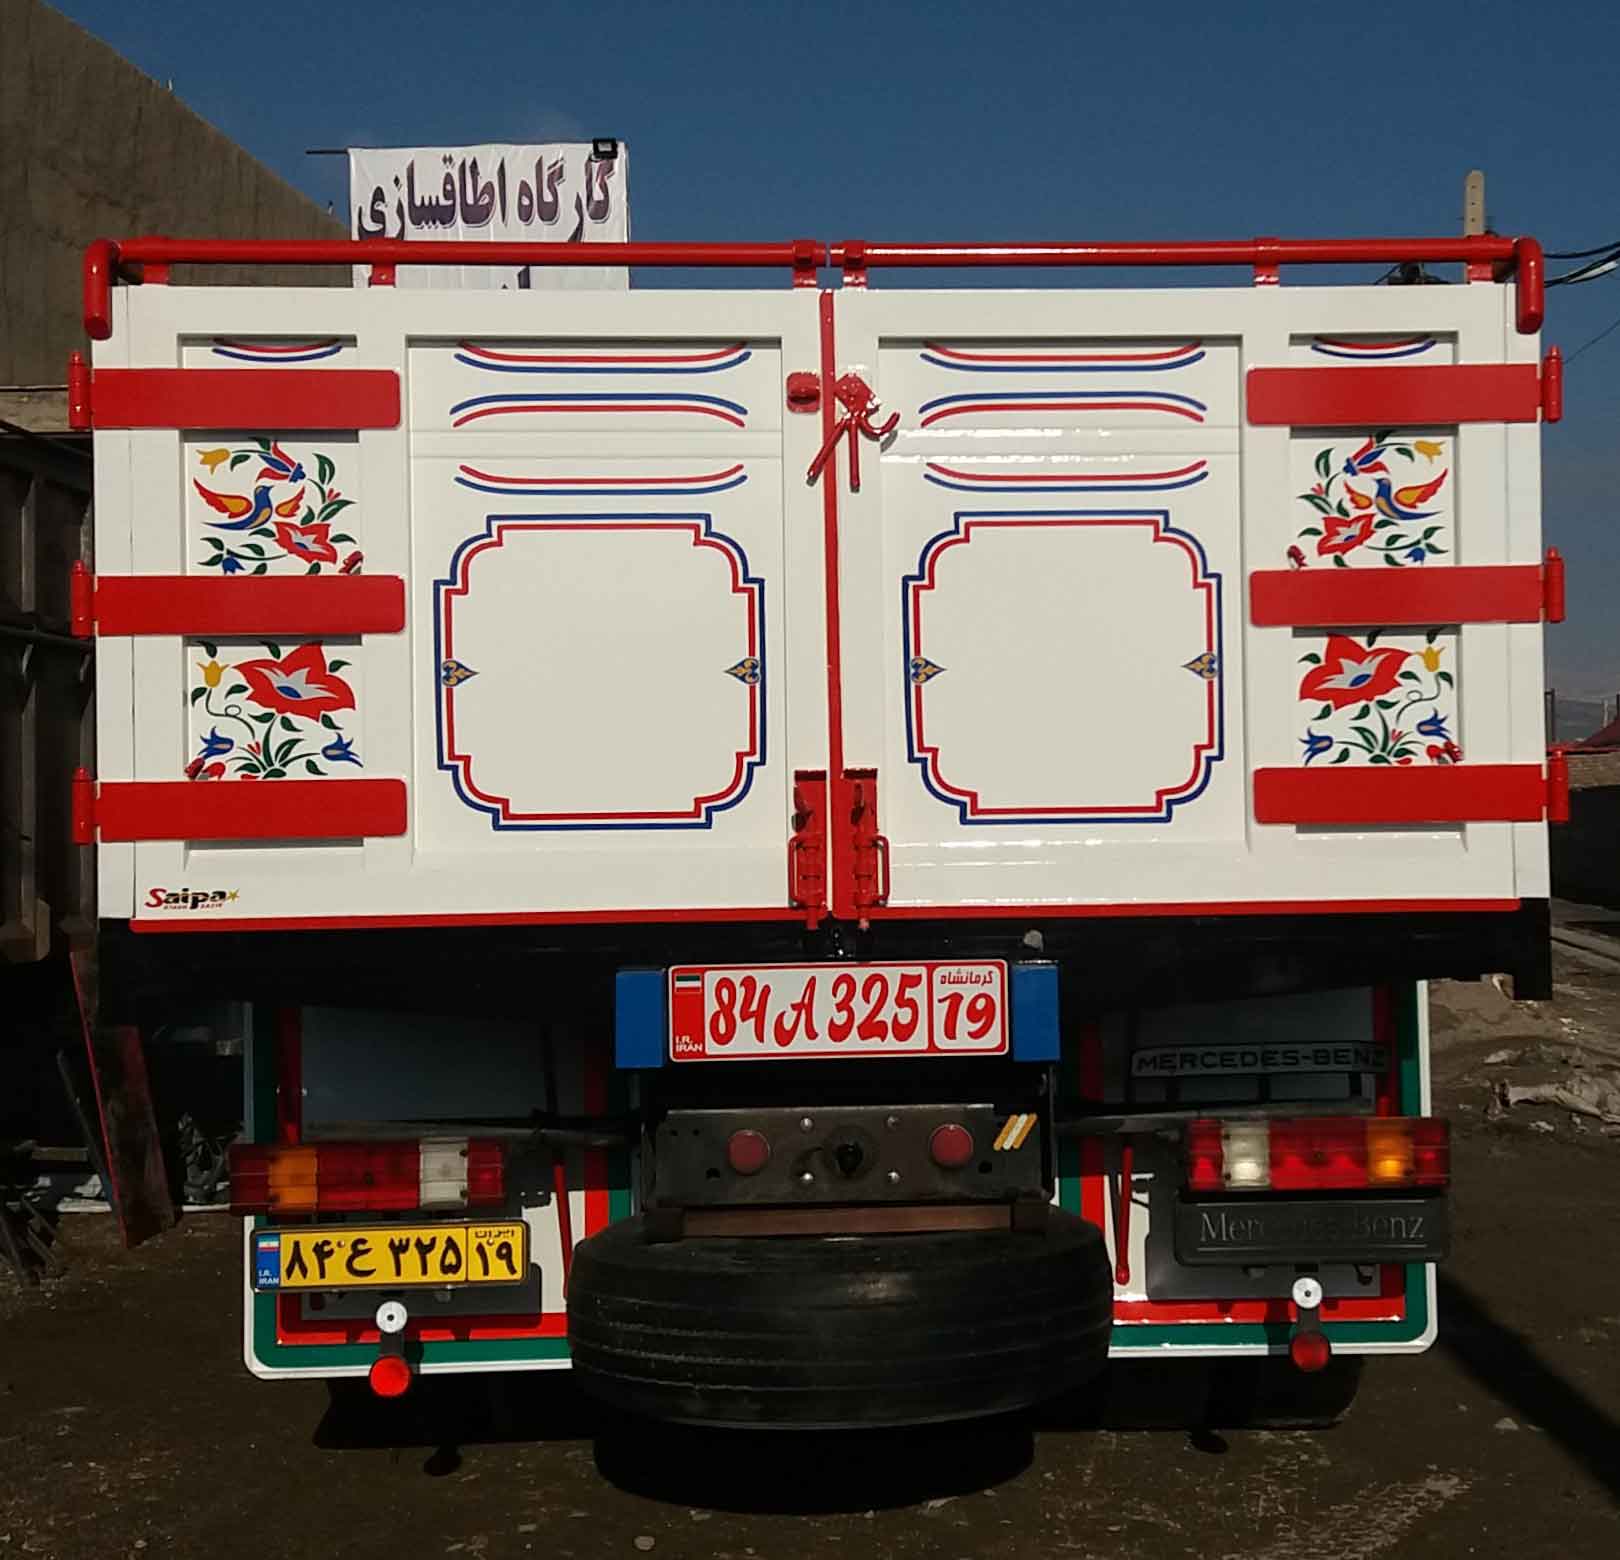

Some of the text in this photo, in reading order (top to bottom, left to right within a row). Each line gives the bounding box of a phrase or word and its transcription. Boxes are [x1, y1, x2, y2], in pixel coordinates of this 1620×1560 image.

[144, 888, 227, 909] Saipa
[940, 968, 993, 986] کرمانشاه
[709, 972, 771, 1046] 84
[827, 972, 923, 1044] 325
[937, 991, 996, 1041] 19
[675, 1043, 703, 1053] IRAN
[388, 1236, 463, 1278] ۳۲۵
[475, 1240, 518, 1277] ۱۹
[258, 1277, 280, 1285] IRAN
